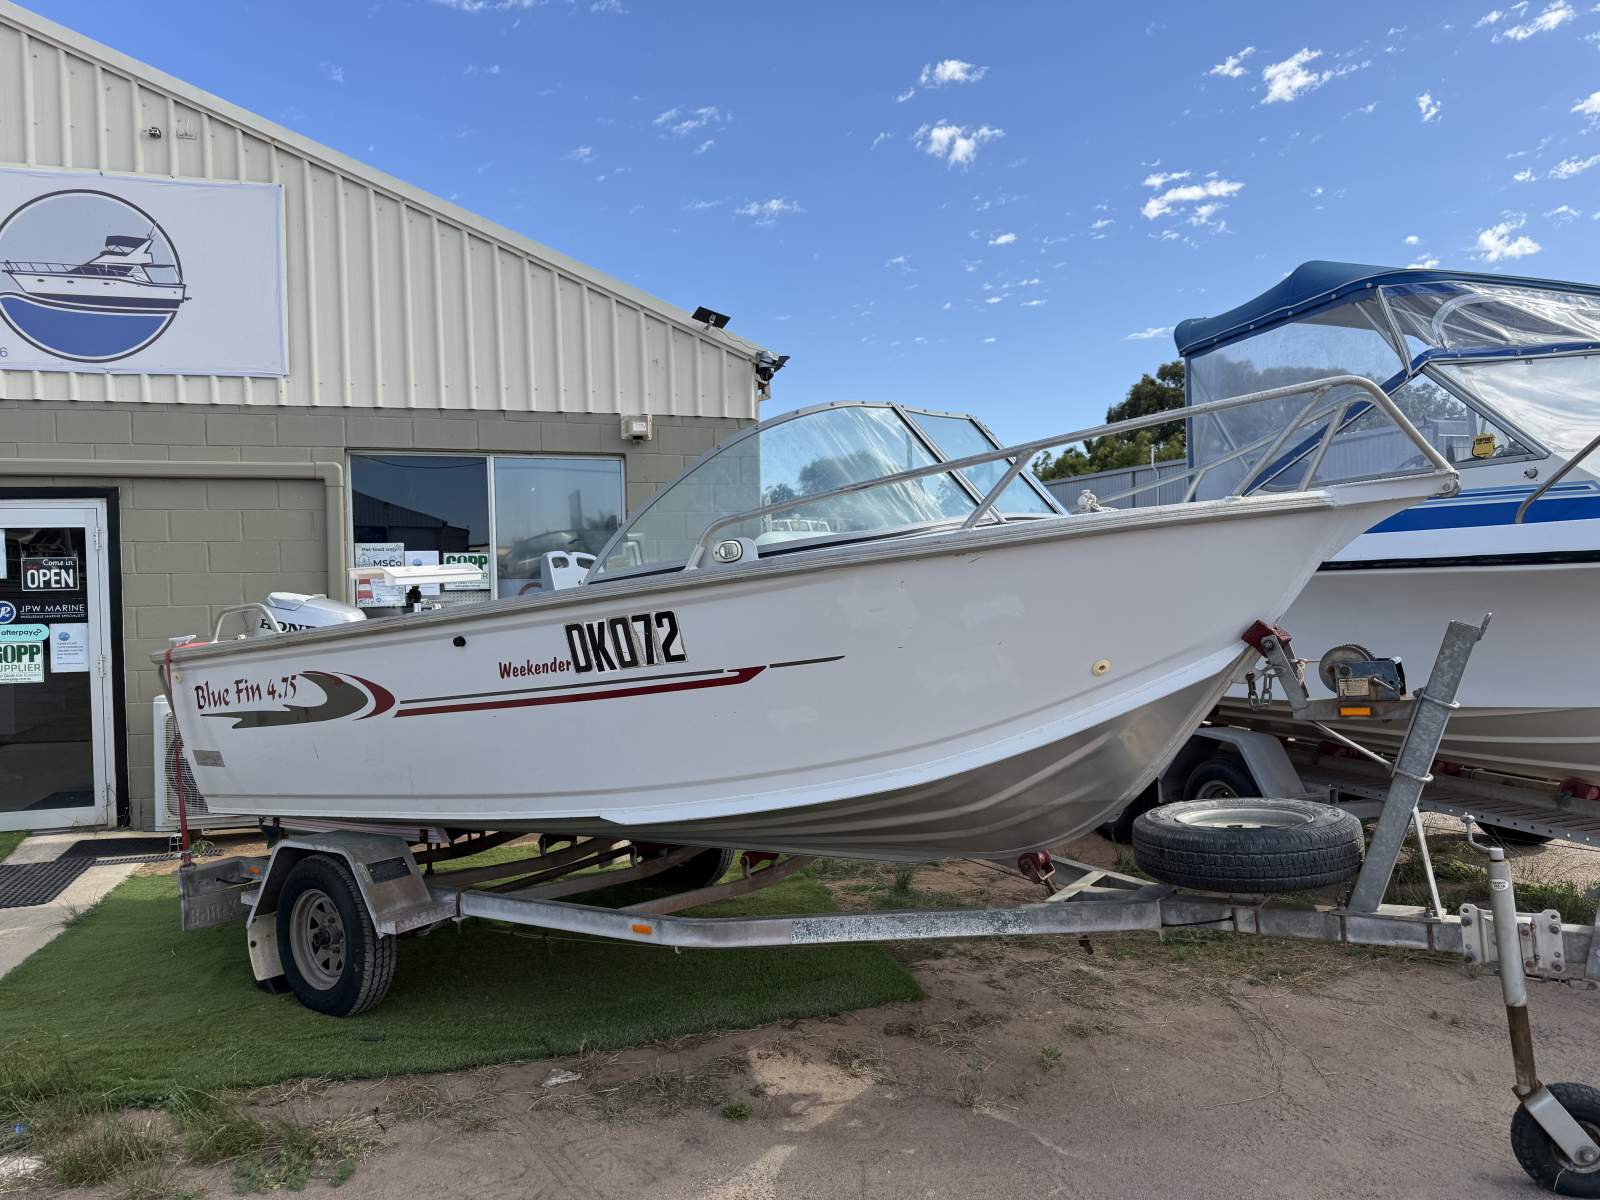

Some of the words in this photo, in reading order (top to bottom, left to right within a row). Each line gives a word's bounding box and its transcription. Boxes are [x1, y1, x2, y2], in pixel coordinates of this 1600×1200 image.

[42, 558, 64, 566] Come
[373, 559, 402, 567] MSCo
[27, 568, 74, 589] OPEN
[20, 605, 41, 613] JPW
[45, 603, 85, 612] MARINE
[1, 629, 33, 637] afterpay
[0, 644, 41, 664] OPP
[499, 656, 571, 680] Weekender
[195, 681, 230, 710] Blue
[234, 678, 262, 703] Fin
[267, 674, 297, 700] 4.75
